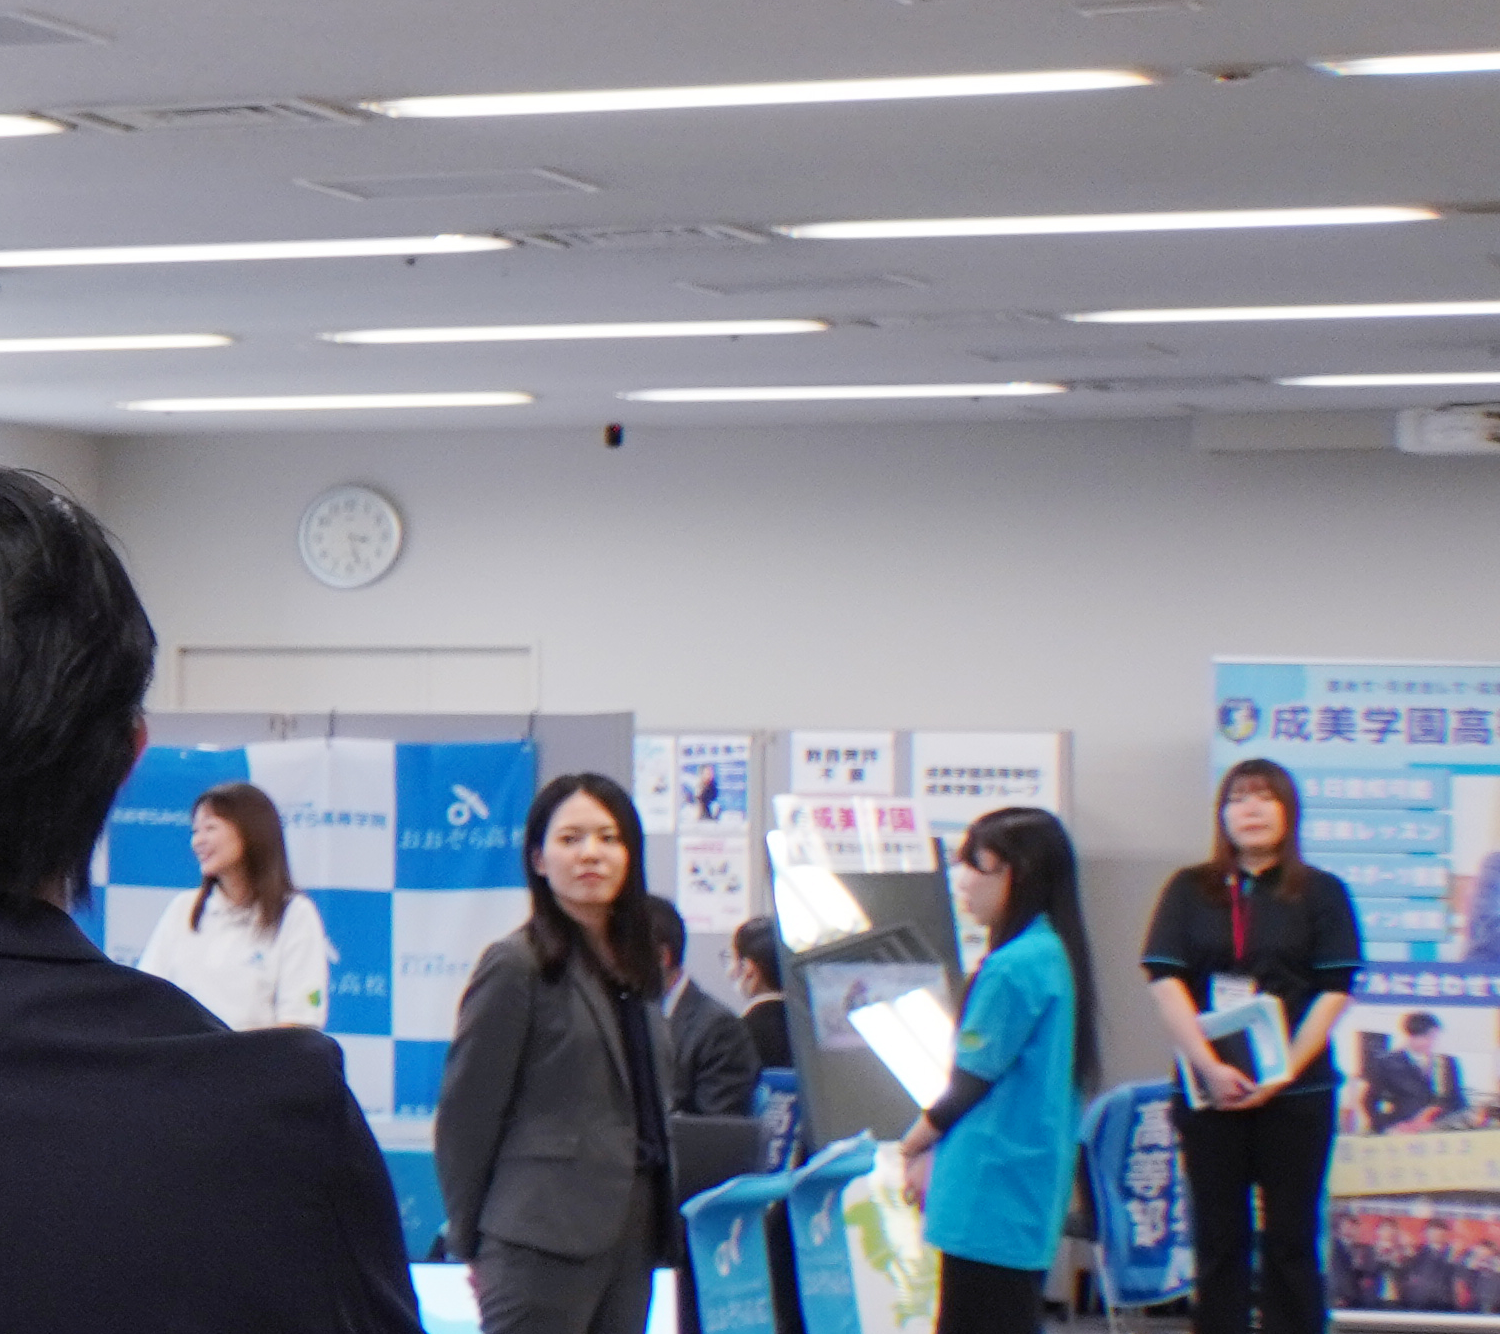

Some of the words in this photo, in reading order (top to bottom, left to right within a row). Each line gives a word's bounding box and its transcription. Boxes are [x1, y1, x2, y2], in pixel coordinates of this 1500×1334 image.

[1270, 704, 1500, 745] 成美学園高
